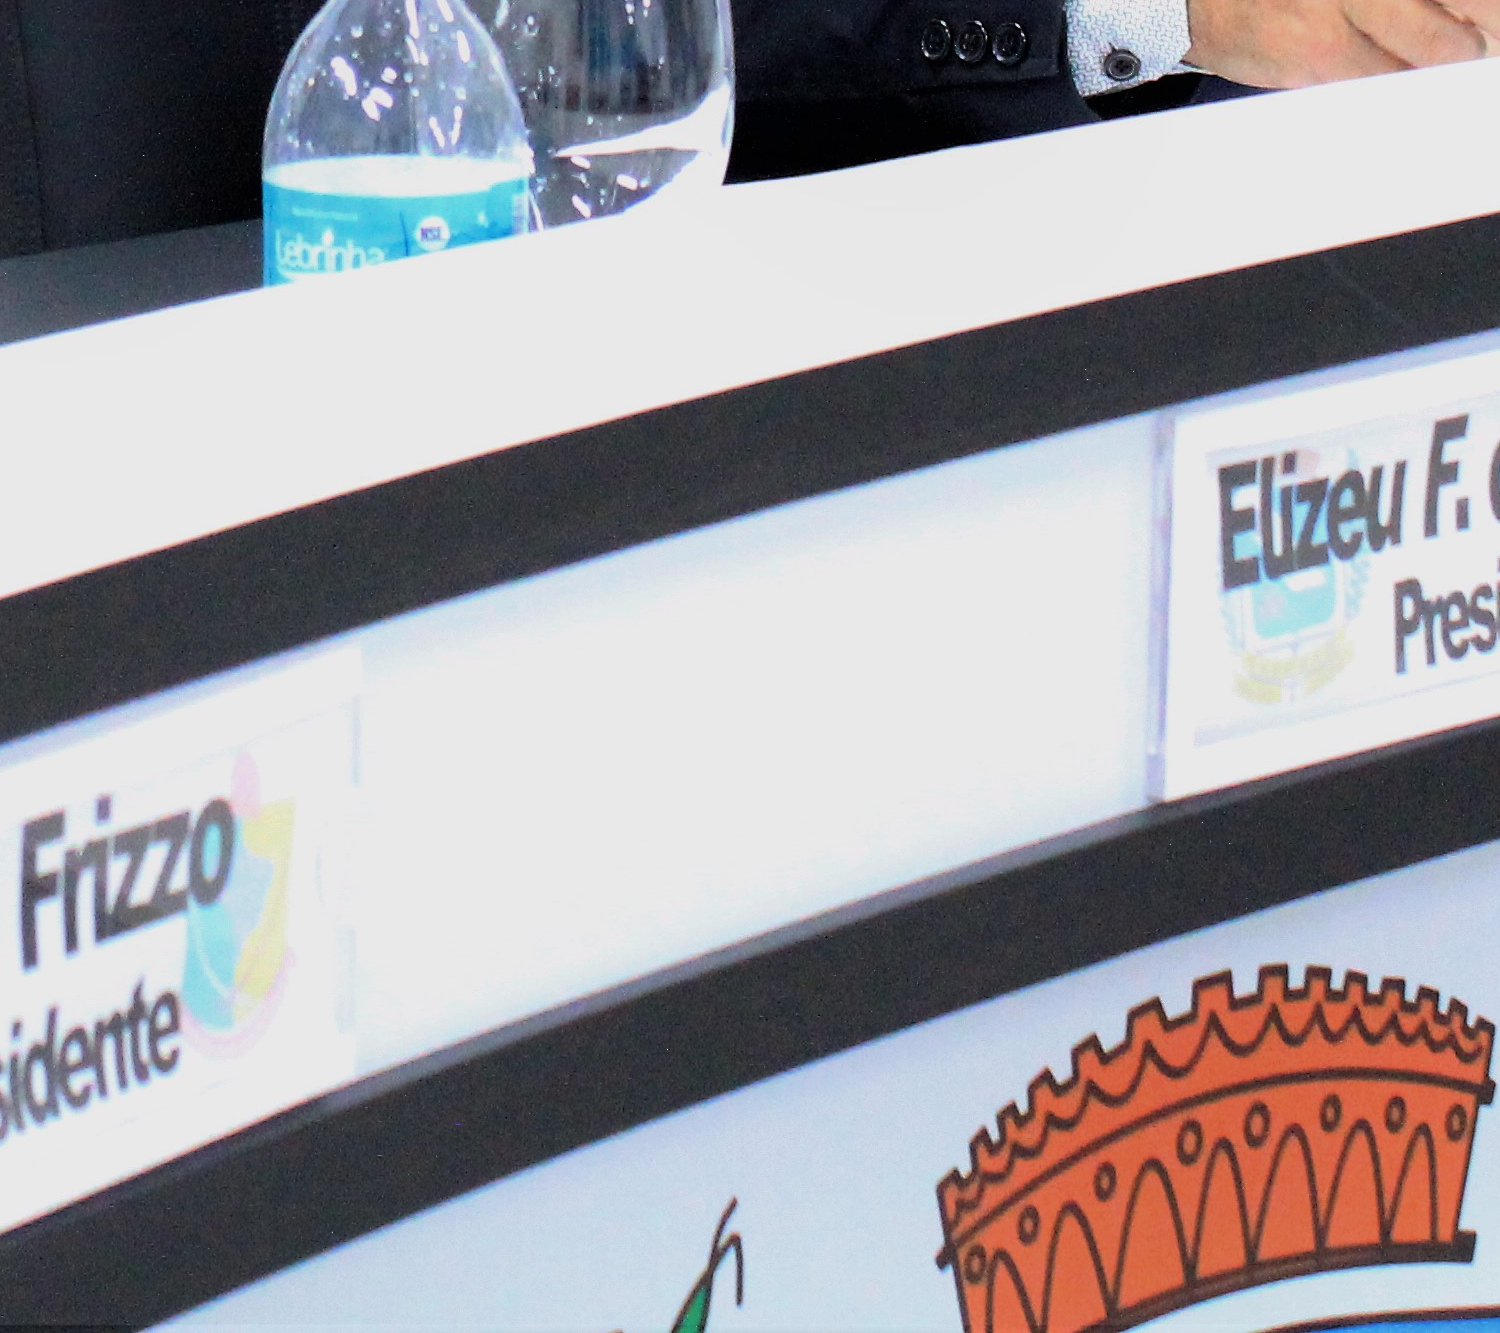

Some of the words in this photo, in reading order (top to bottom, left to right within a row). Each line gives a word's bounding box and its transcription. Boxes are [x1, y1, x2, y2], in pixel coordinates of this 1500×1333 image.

[1217, 450, 1407, 592] Elizeu
[1424, 414, 1469, 538] F.
[19, 795, 236, 971] Frizzo
